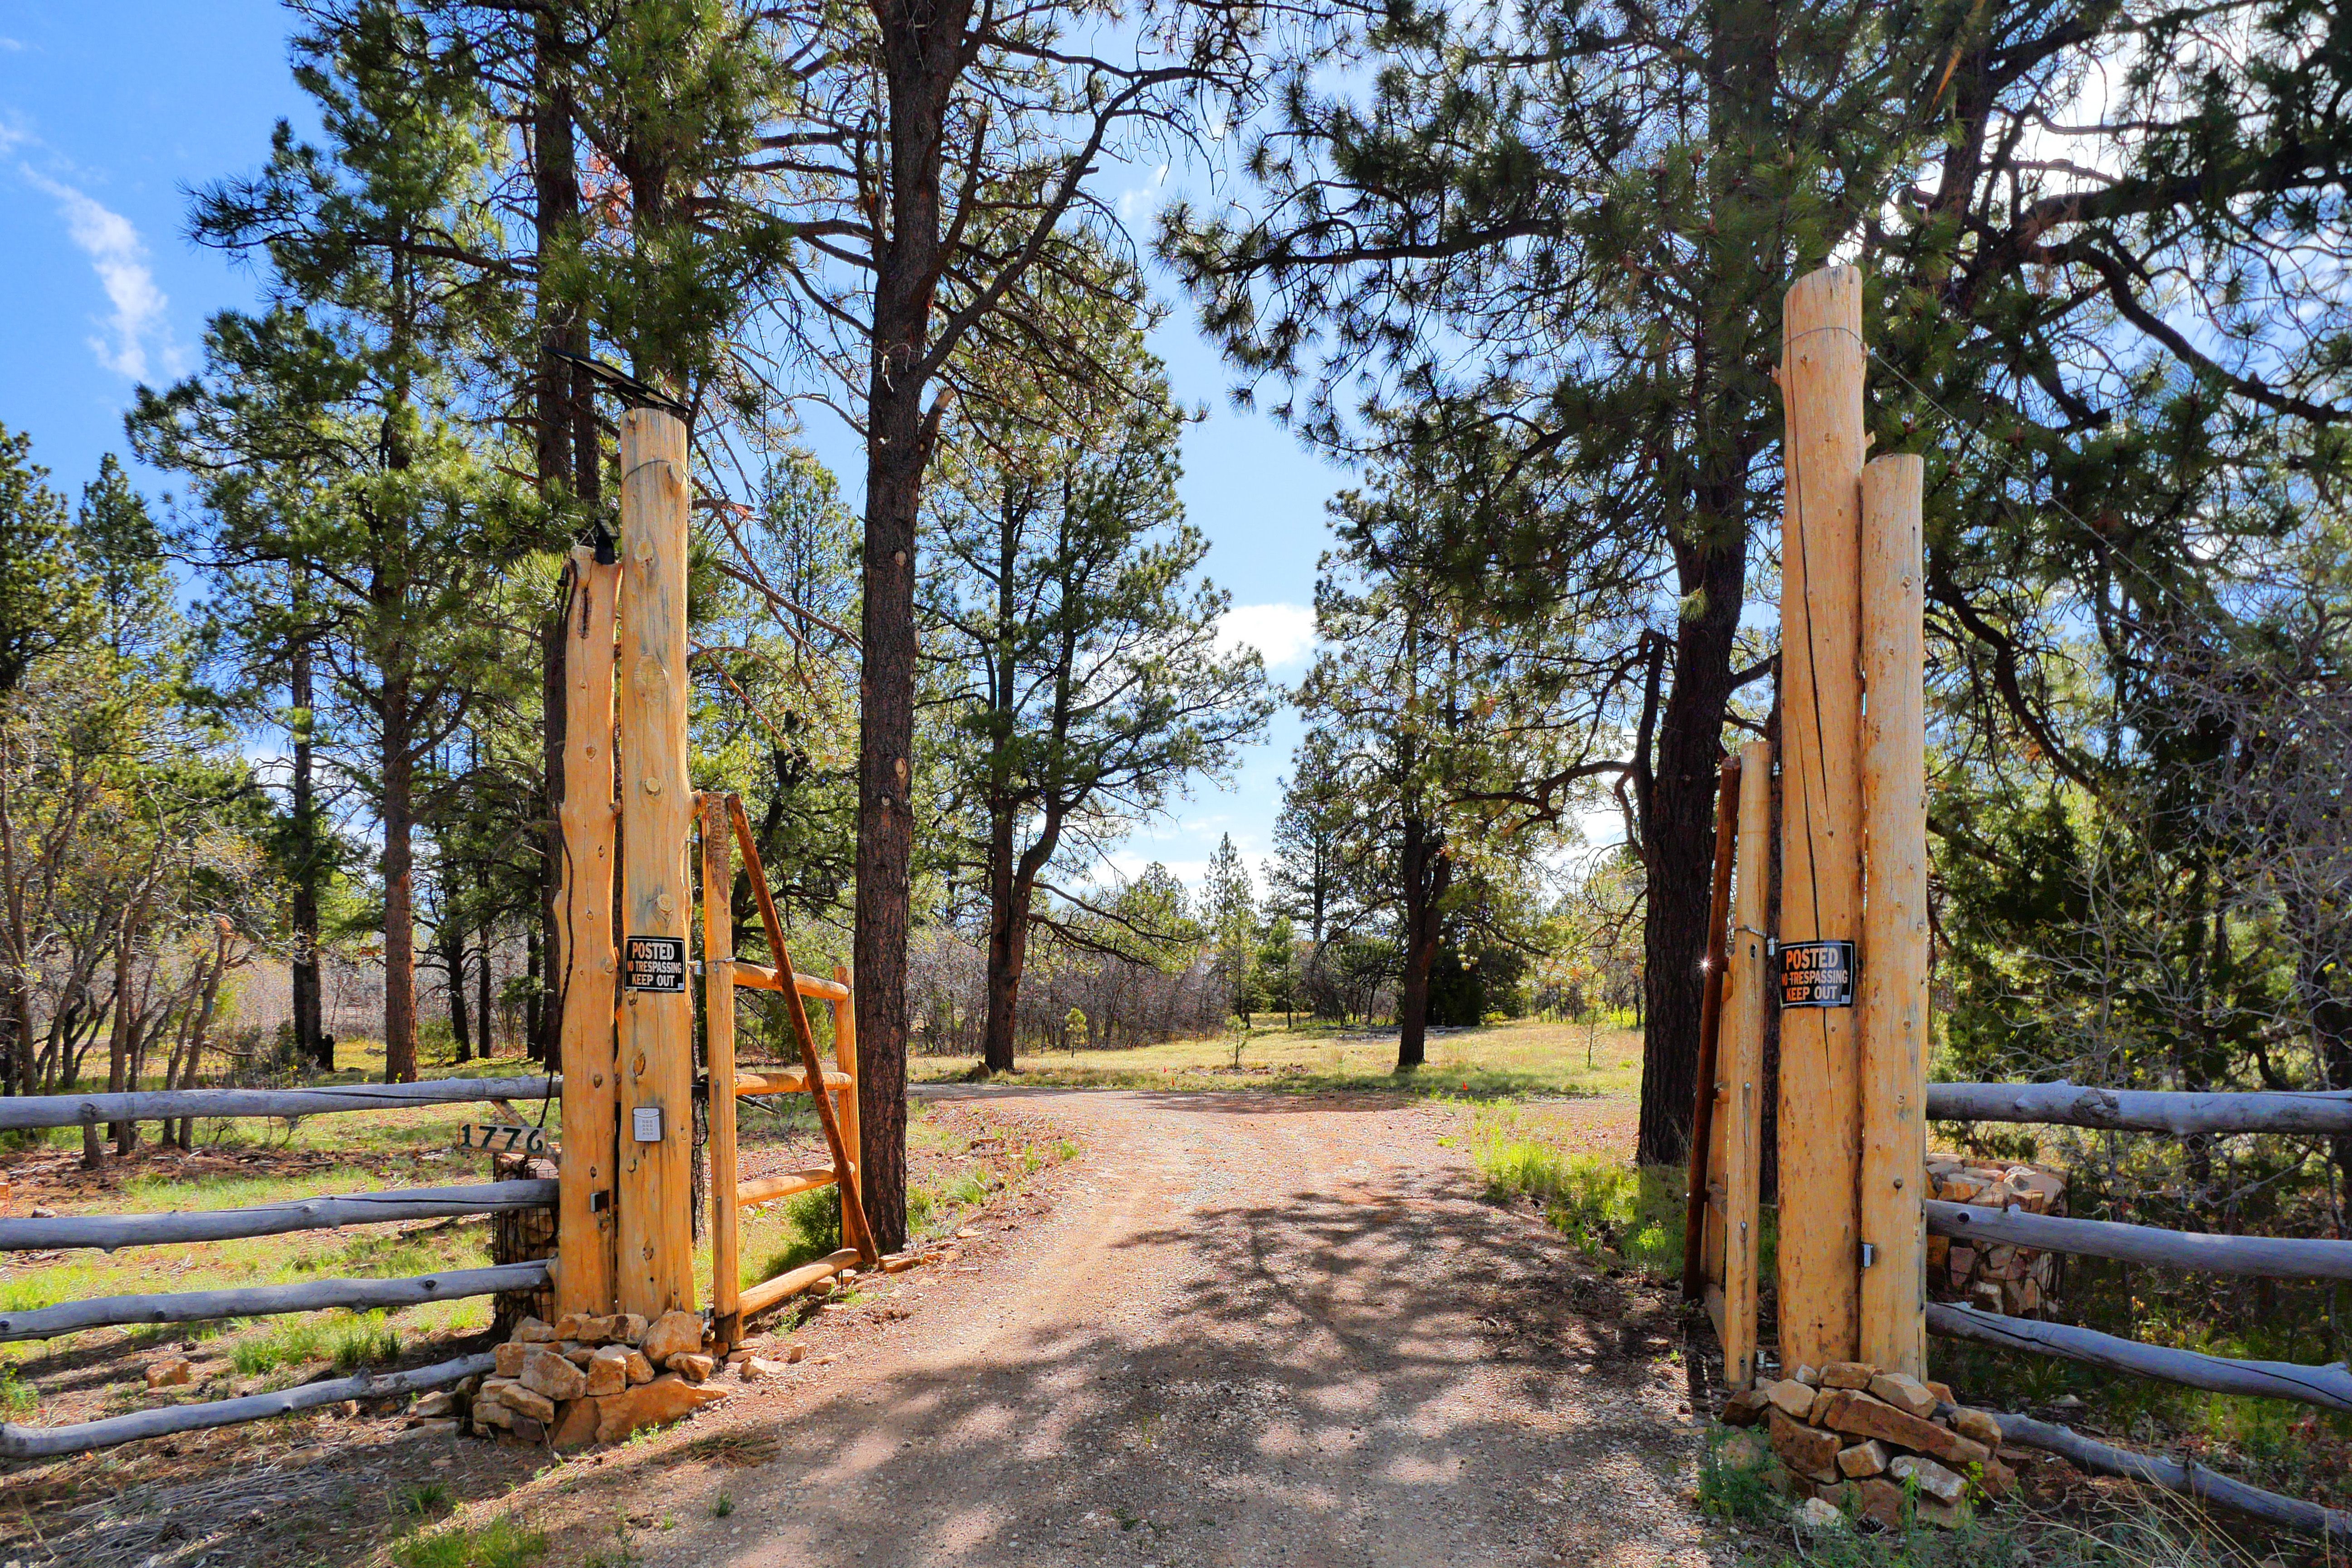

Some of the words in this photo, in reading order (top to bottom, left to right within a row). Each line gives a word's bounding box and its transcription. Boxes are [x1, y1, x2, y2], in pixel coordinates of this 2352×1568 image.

[632, 942, 675, 960] POSTED
[1786, 947, 1838, 970] POSTED
[627, 960, 634, 972] NO
[635, 960, 681, 974] TRESPASSING
[632, 974, 653, 985] KEEP
[657, 975, 675, 986] OUT
[1781, 973, 1788, 986] NO
[1789, 970, 1848, 985] TRESPASSING
[1786, 986, 1810, 1001] KEEP
[1814, 985, 1838, 1000] OUT
[460, 1124, 543, 1152] 1776
